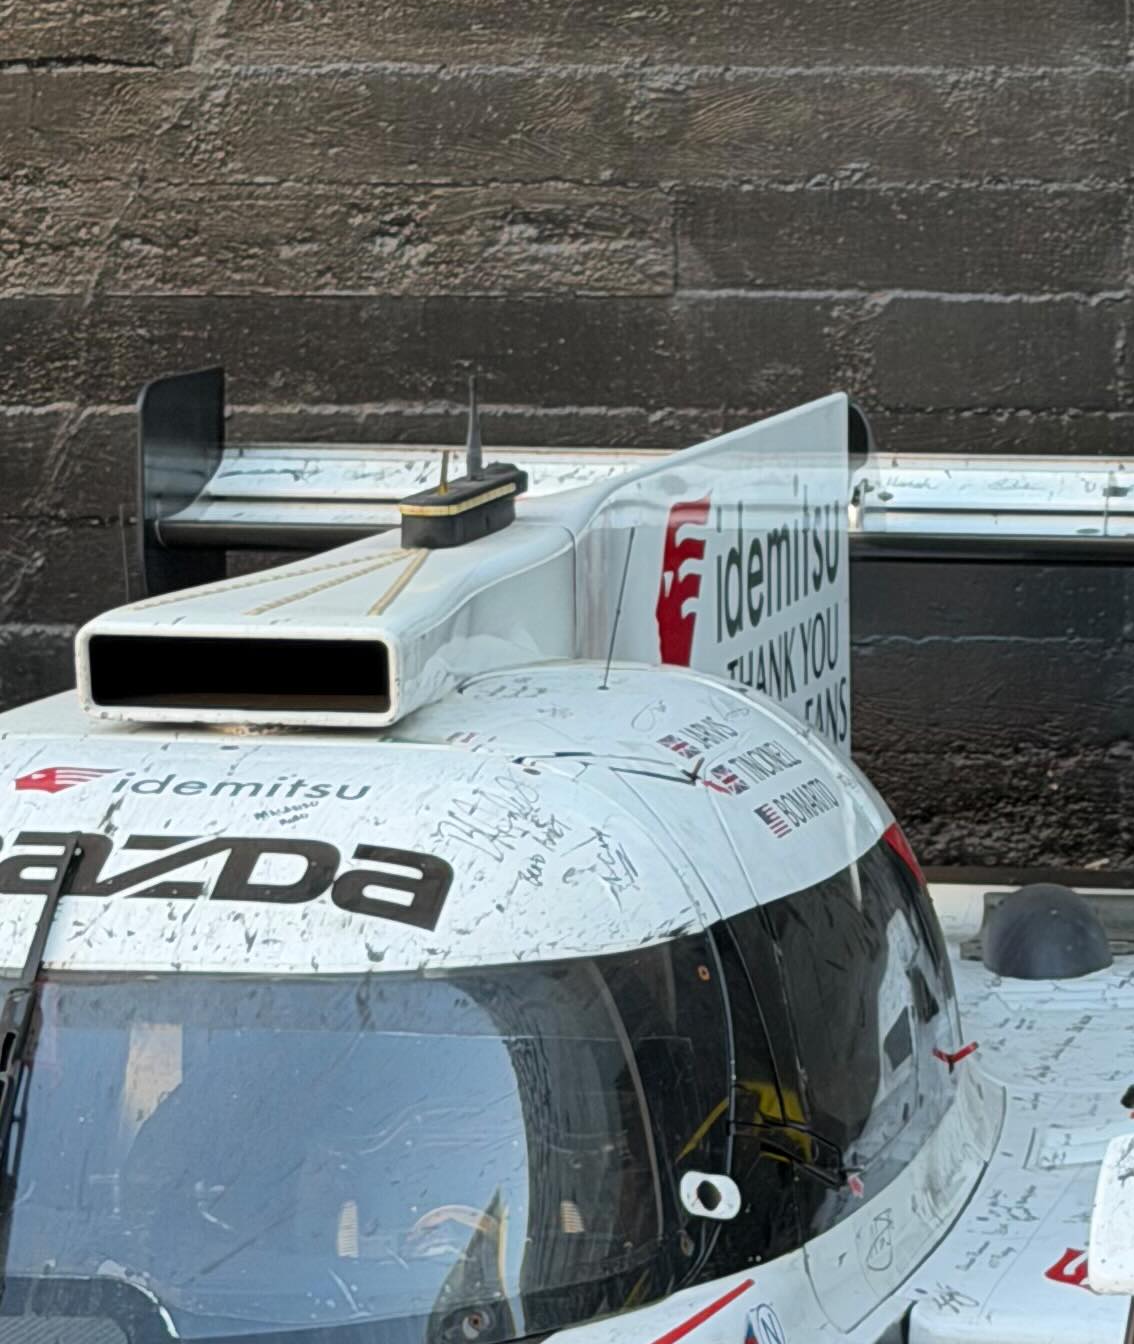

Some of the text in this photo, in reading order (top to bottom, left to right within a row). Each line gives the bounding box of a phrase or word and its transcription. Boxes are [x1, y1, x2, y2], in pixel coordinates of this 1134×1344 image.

[714, 474, 840, 644] idemitsu
[800, 603, 840, 680] YOU
[112, 771, 372, 801] idemitsu
